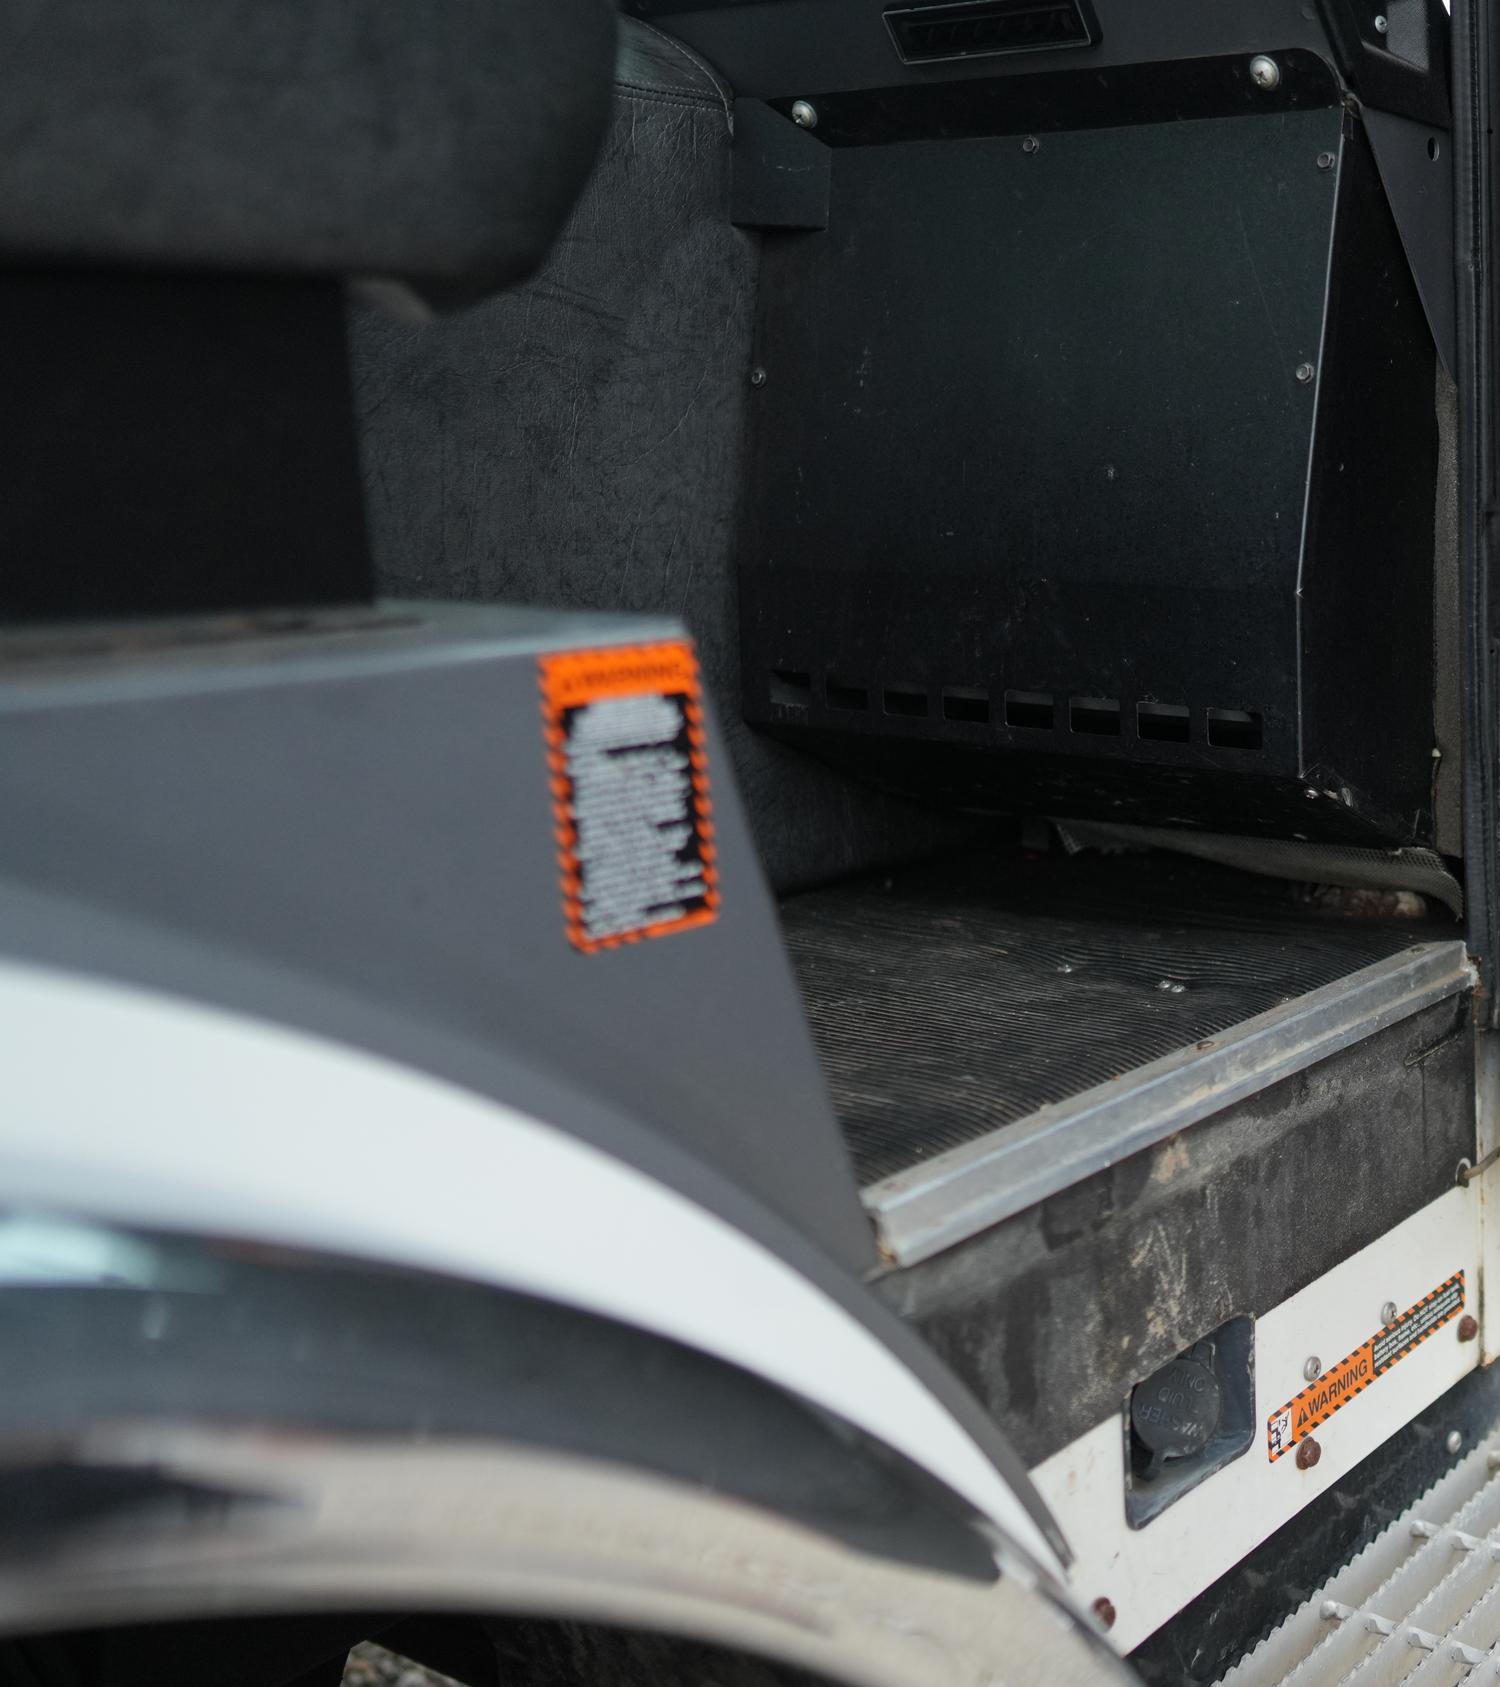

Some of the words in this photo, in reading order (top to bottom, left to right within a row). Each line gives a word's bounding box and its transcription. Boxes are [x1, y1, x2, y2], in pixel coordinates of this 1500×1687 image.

[1385, 1328, 1400, 1342] serious
[1374, 1345, 1388, 1361] battery
[1308, 1360, 1368, 1416] WARNING
